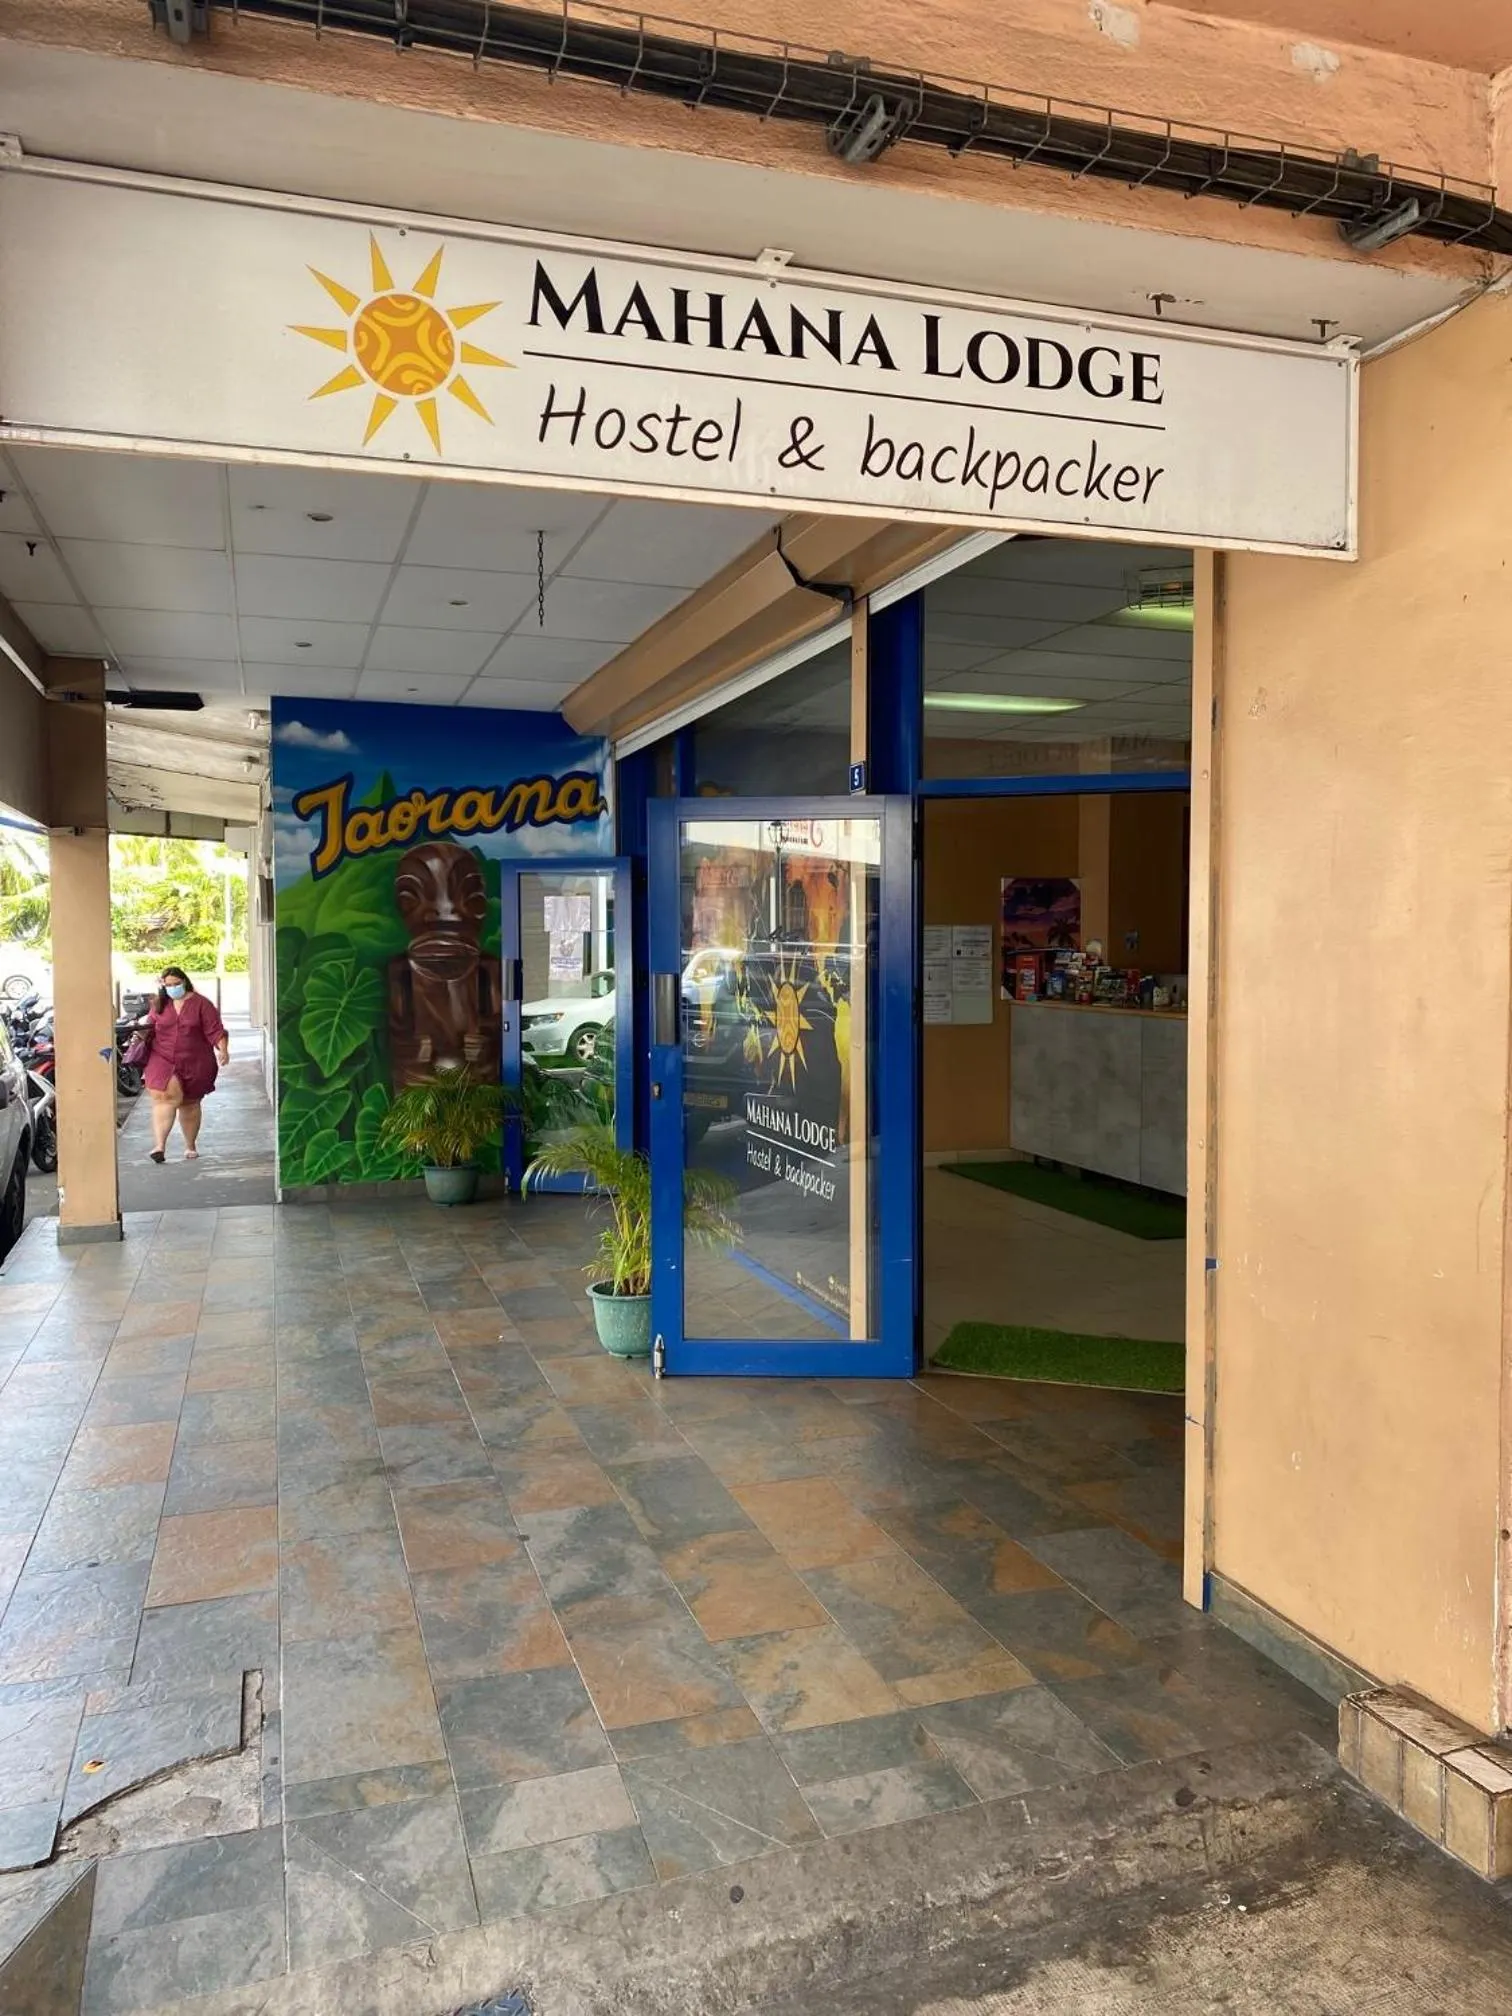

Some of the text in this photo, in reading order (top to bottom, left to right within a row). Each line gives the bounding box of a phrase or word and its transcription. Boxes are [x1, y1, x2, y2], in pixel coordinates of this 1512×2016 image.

[528, 259, 1164, 405] MAHANA LODGE
[538, 384, 1165, 509] Hostel & backpacker
[854, 768, 860, 786] 5
[747, 1099, 792, 1136] MAHANA
[795, 1112, 836, 1153] LODGE
[747, 1142, 836, 1201] Hostel & backpacker
